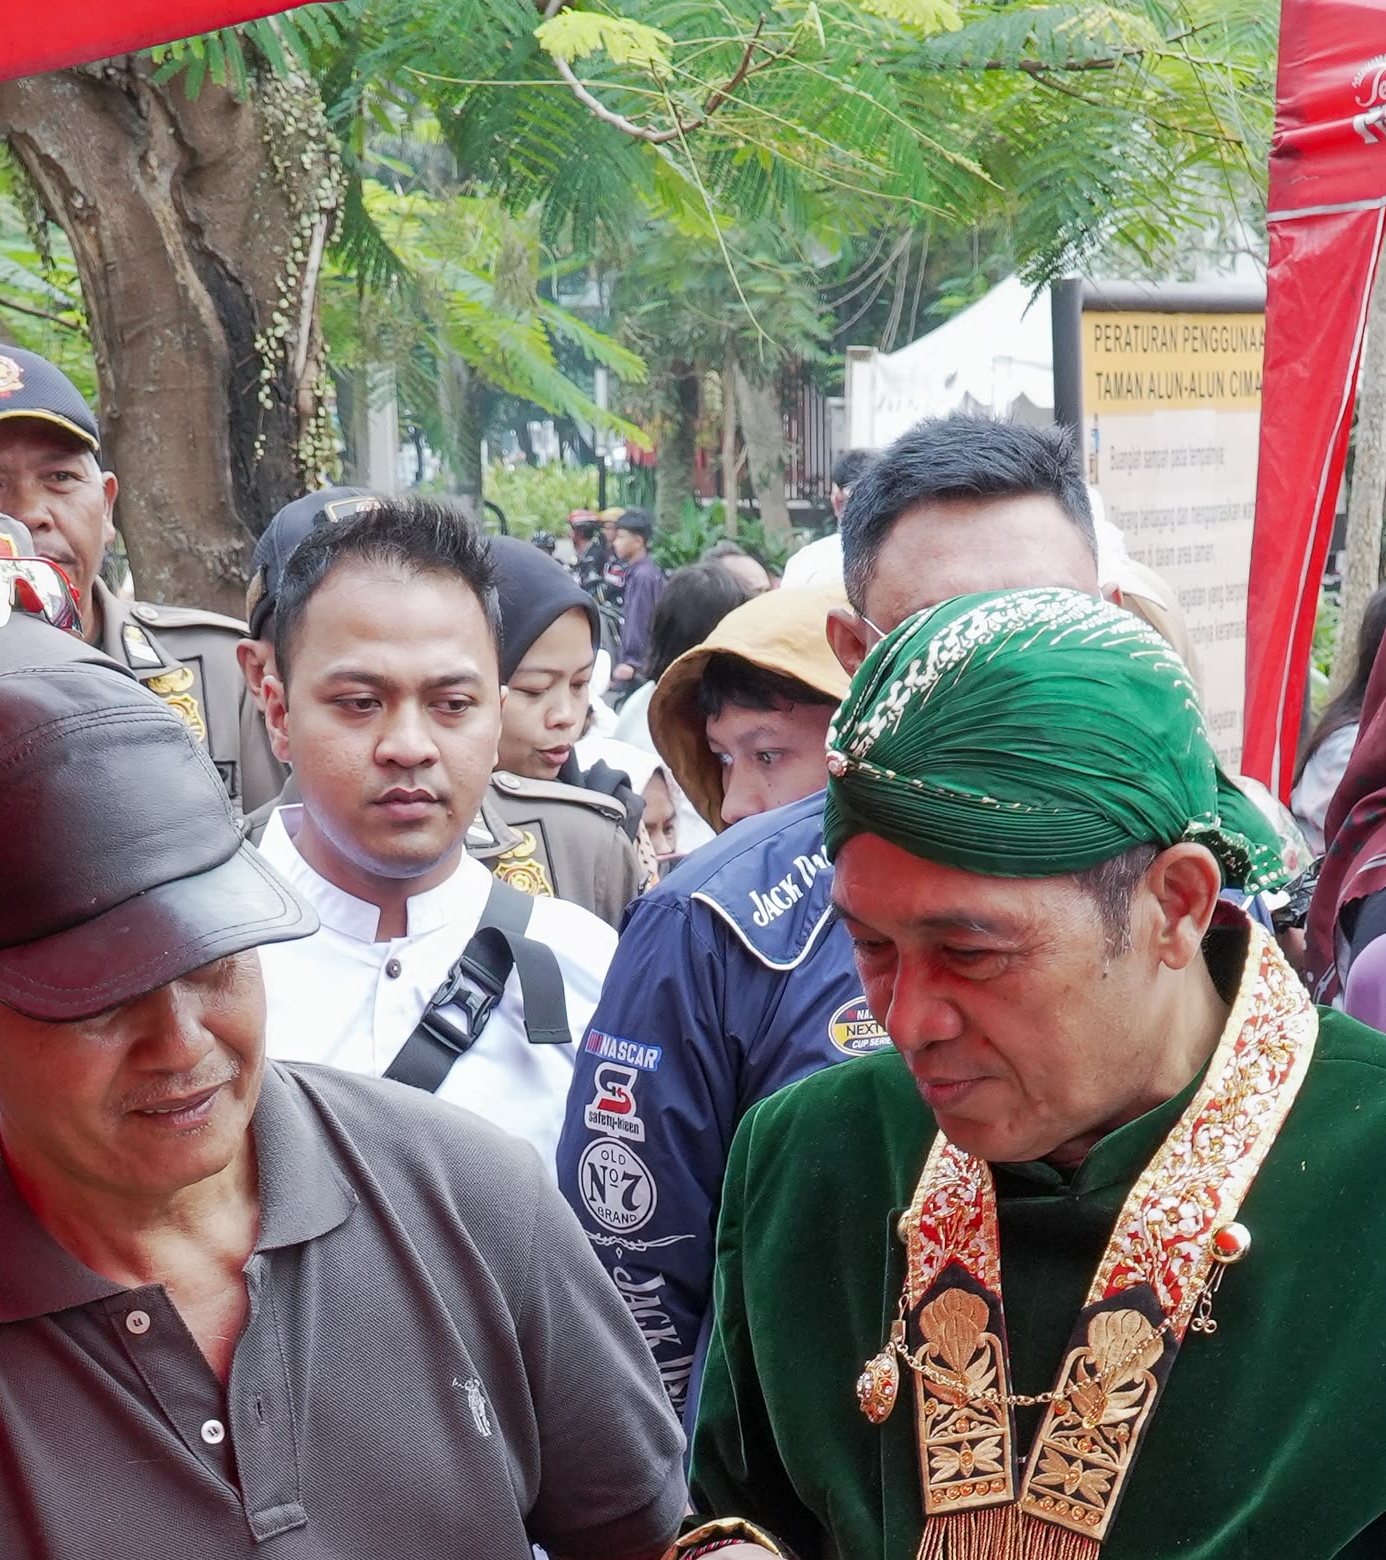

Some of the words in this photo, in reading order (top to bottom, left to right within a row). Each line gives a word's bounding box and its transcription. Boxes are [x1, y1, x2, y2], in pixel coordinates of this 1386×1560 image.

[1094, 324, 1178, 353] PERATURAN
[1183, 324, 1265, 353] PENGGUNAA
[1096, 371, 1144, 400] TAMAN
[1148, 371, 1226, 399] ALUN-ALUN
[1229, 370, 1262, 398] CIMA
[748, 873, 804, 927] JACK
[847, 1023, 880, 1036] NEXT
[852, 1038, 869, 1049] CUP
[869, 1036, 893, 1047] SERIE
[598, 1034, 659, 1069] NASCAR
[588, 1110, 640, 1135] safety-kleen
[600, 1149, 627, 1166] OLD
[597, 1206, 638, 1225] BRAND
[613, 1266, 682, 1350] JACK
